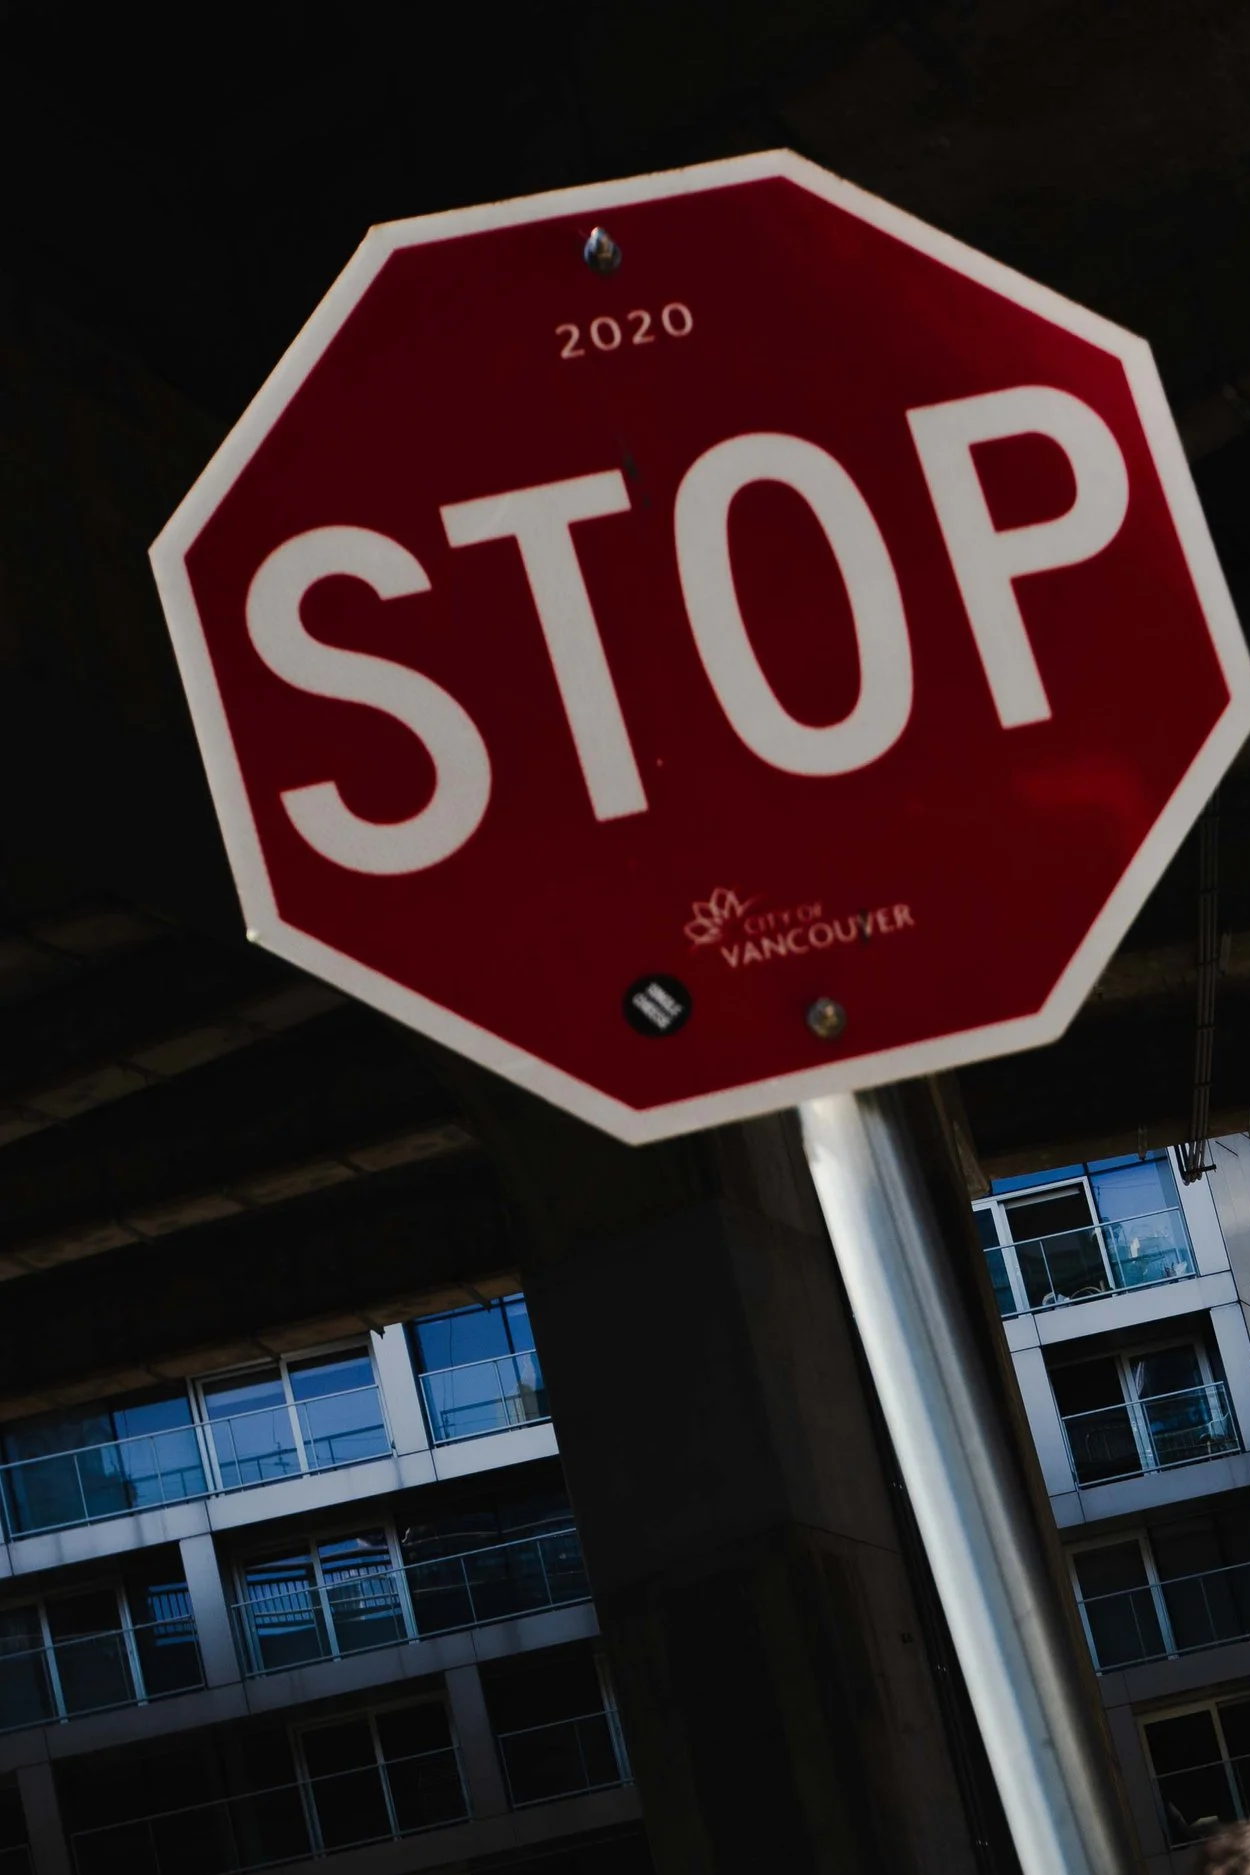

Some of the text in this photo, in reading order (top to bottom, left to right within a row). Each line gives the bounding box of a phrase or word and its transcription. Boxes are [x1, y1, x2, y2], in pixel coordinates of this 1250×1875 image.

[554, 301, 694, 360] 2020
[245, 384, 1131, 876] STOP
[719, 903, 916, 968] VANCOUVER
[743, 908, 791, 936] CITY
